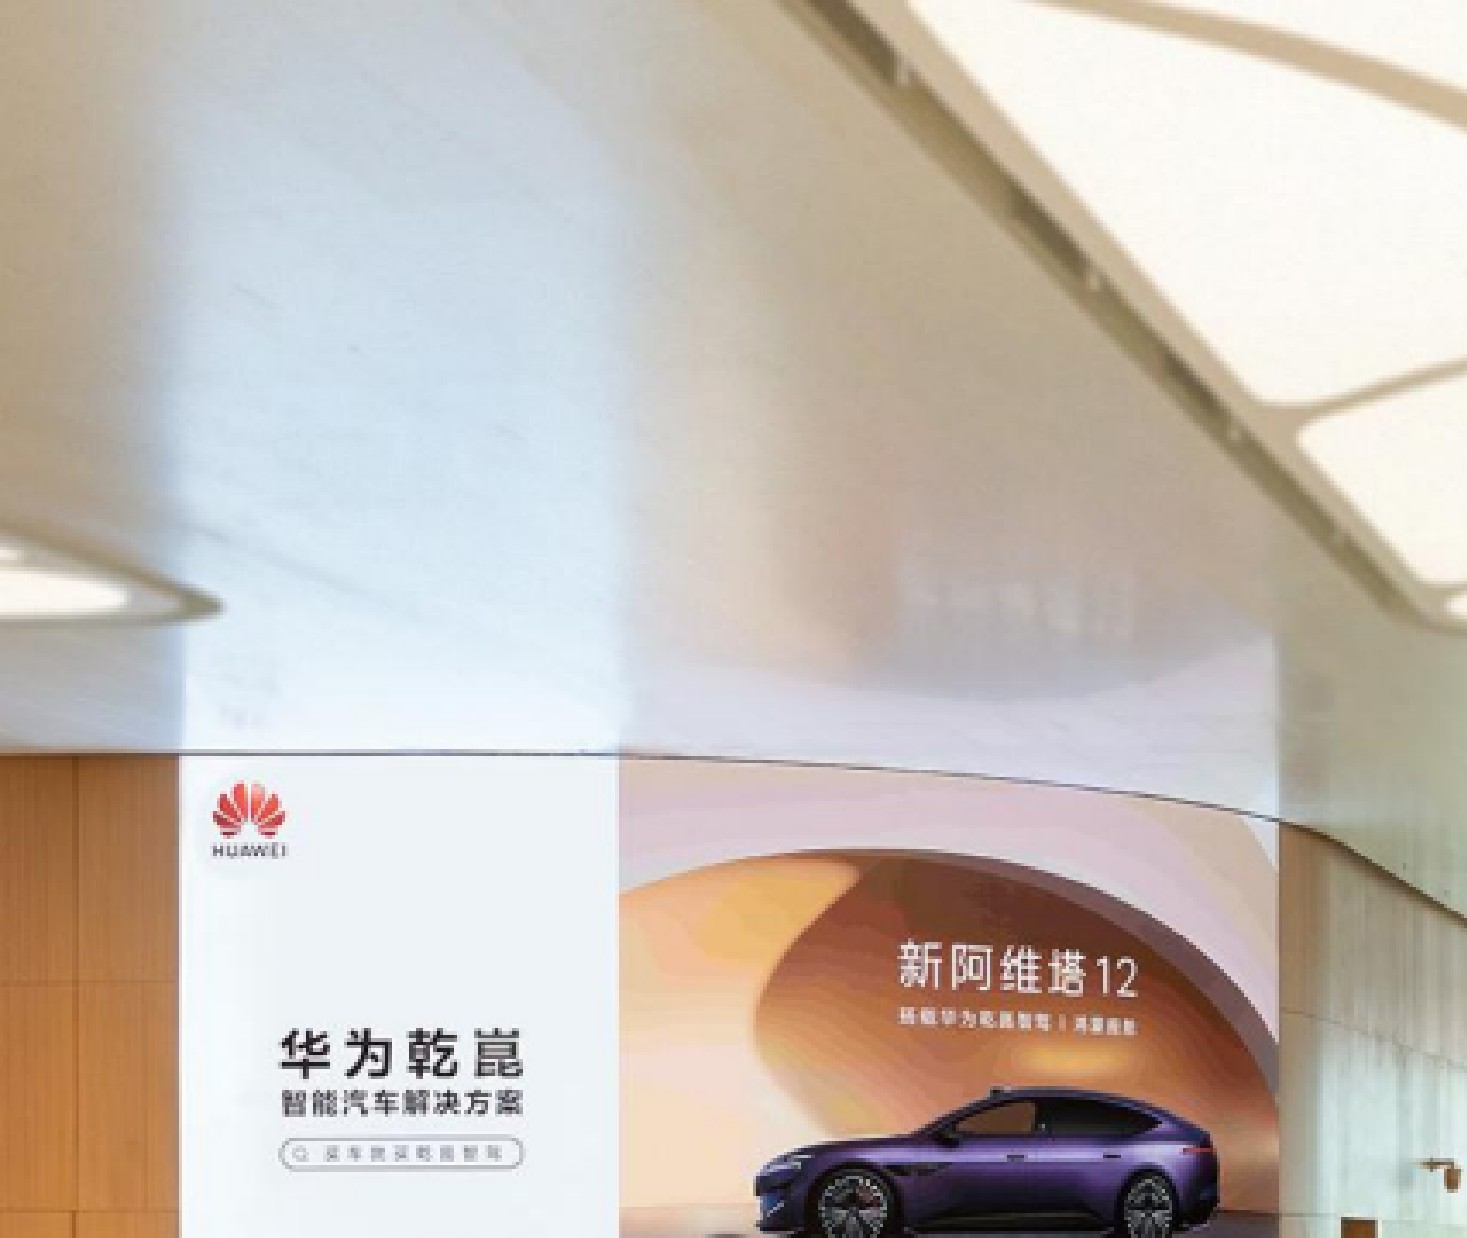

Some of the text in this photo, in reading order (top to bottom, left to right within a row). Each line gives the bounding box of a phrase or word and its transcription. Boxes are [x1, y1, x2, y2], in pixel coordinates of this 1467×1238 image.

[212, 844, 287, 858] HUAWEI
[279, 1028, 524, 1079] 华为乾崑
[281, 1089, 524, 1117] 智能汽车解决方案
